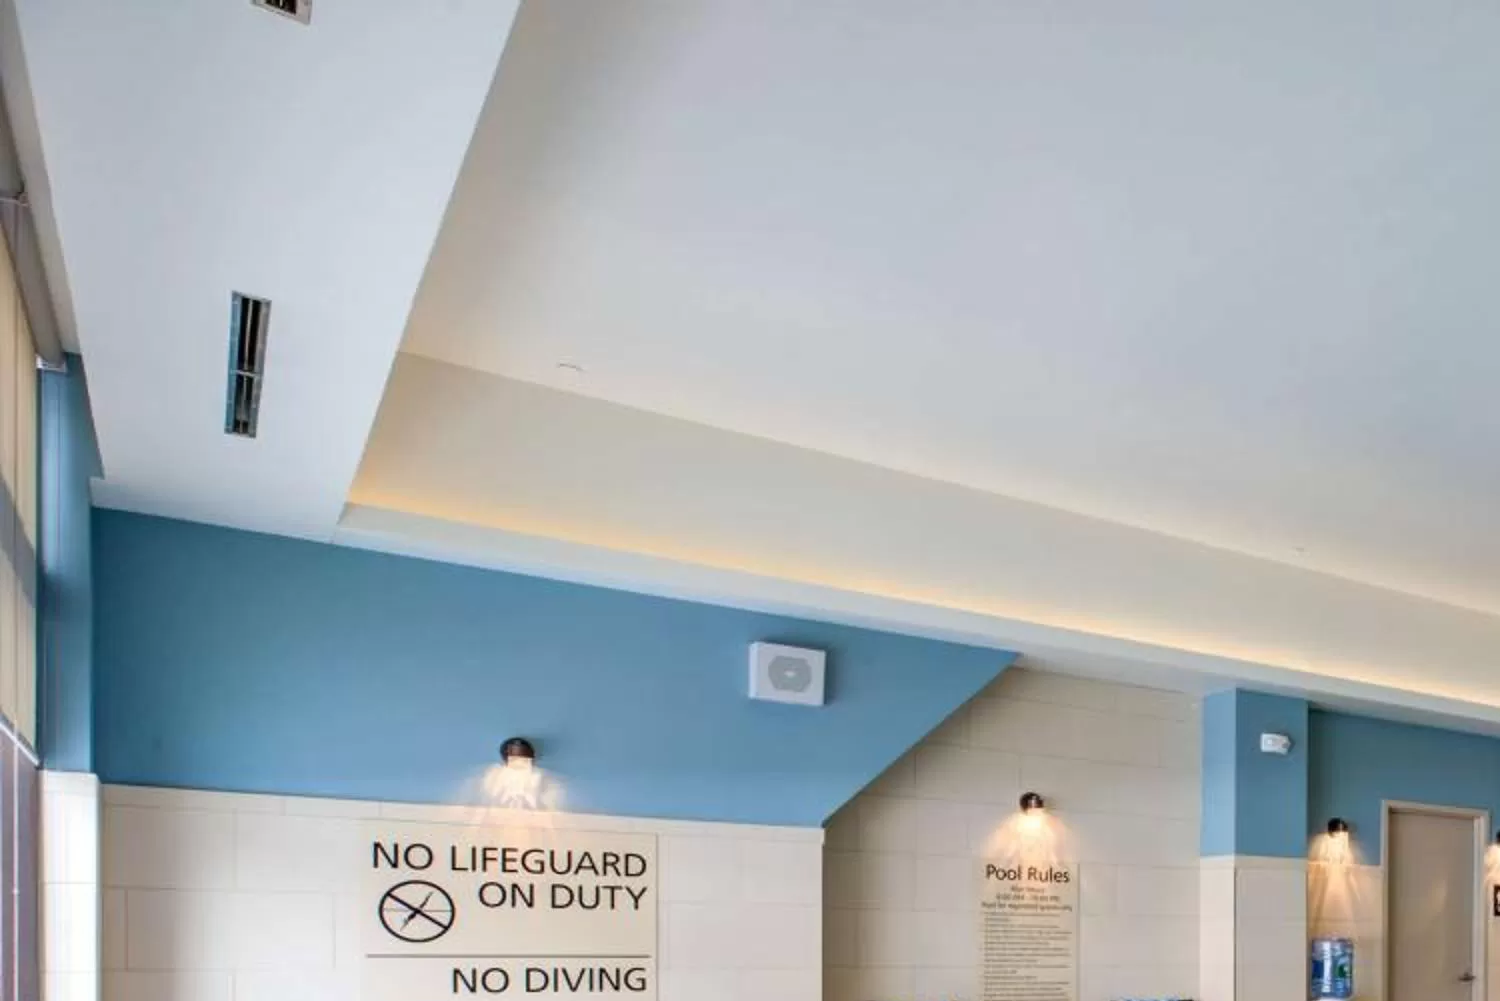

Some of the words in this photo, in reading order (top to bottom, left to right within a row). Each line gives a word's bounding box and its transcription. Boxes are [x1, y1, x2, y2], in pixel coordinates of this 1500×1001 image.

[372, 841, 434, 870] NO
[450, 845, 648, 878] LIFEGUARD
[985, 863, 1022, 881] Pool
[1027, 866, 1071, 884] Rules
[478, 881, 535, 908] ON
[550, 884, 648, 911] DUTY
[452, 967, 509, 994] NO
[524, 967, 648, 993] DIVING
